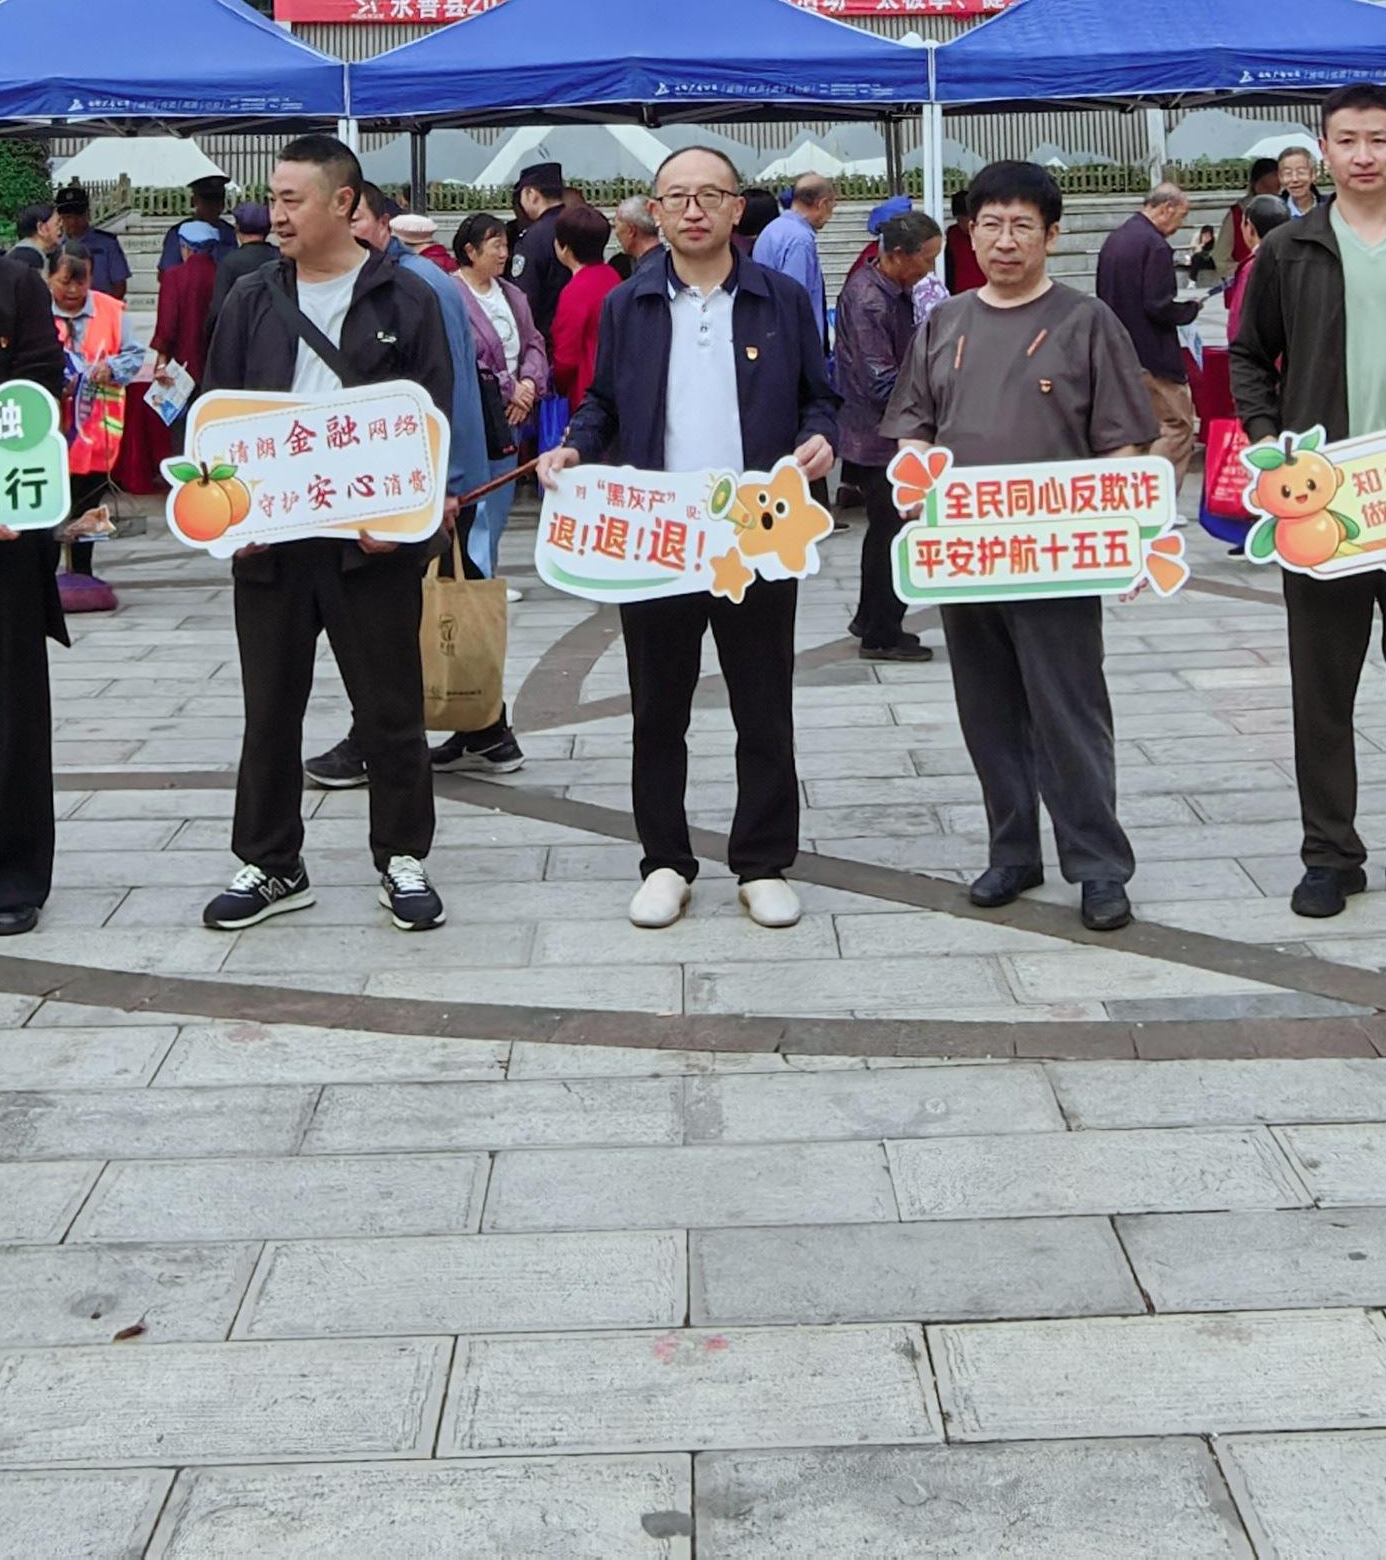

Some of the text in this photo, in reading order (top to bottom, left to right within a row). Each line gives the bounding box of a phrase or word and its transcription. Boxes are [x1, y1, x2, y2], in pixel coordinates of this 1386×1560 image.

[228, 414, 420, 464] 清朗金融网络
[258, 468, 428, 518] 守护安心消费
[944, 471, 1160, 519] 全民同心反欺诈
[915, 530, 1133, 578] 平安护航十五五
